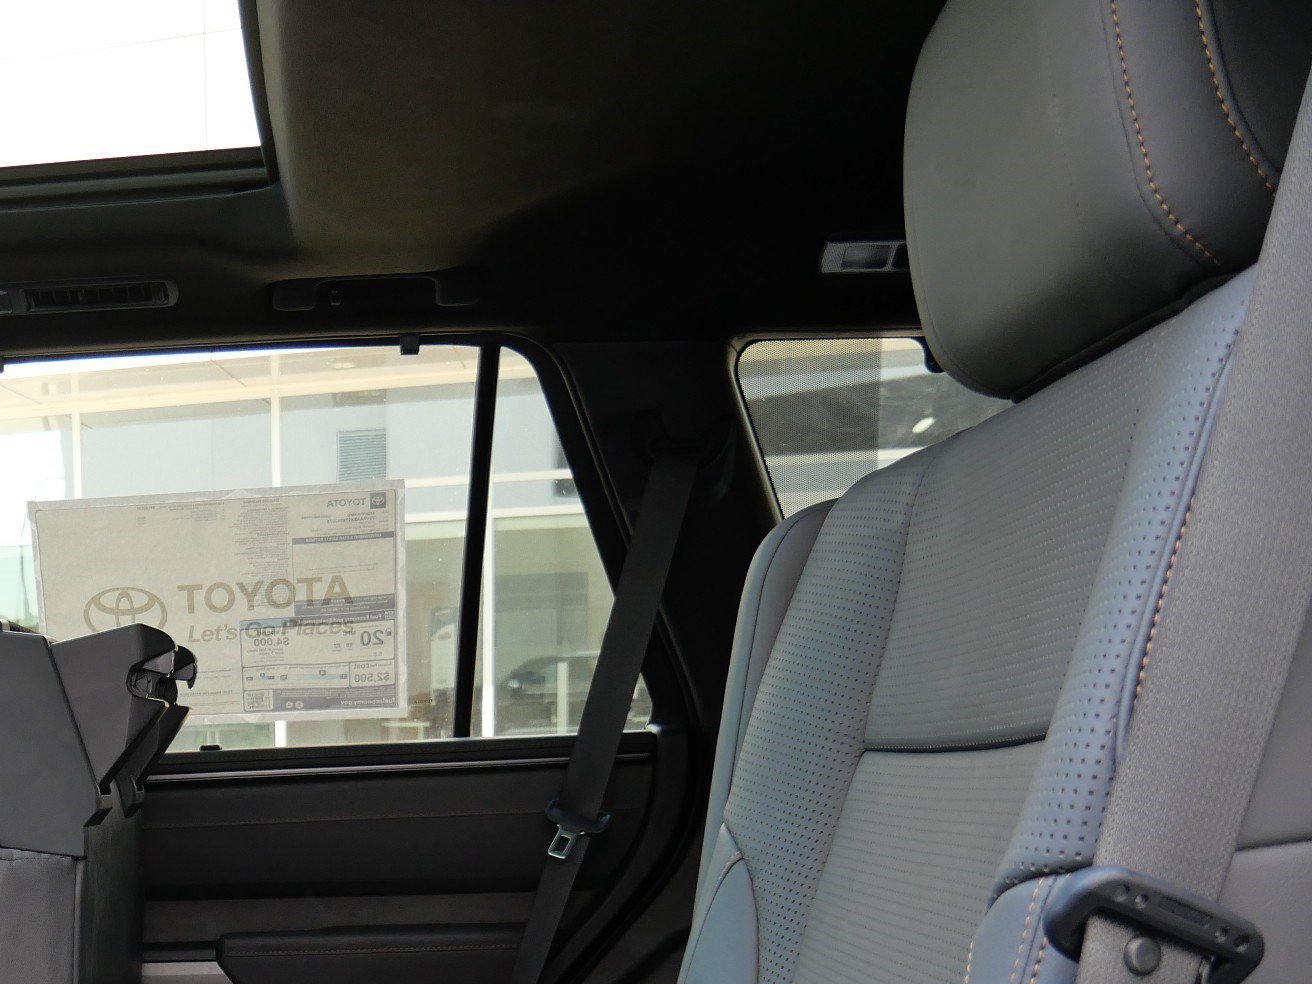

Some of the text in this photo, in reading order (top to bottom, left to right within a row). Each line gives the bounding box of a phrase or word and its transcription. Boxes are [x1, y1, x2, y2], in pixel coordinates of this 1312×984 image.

[177, 575, 354, 614] TOYOTA
[188, 623, 237, 643] Let's
[245, 621, 276, 639] Go
[281, 618, 355, 637] Places
